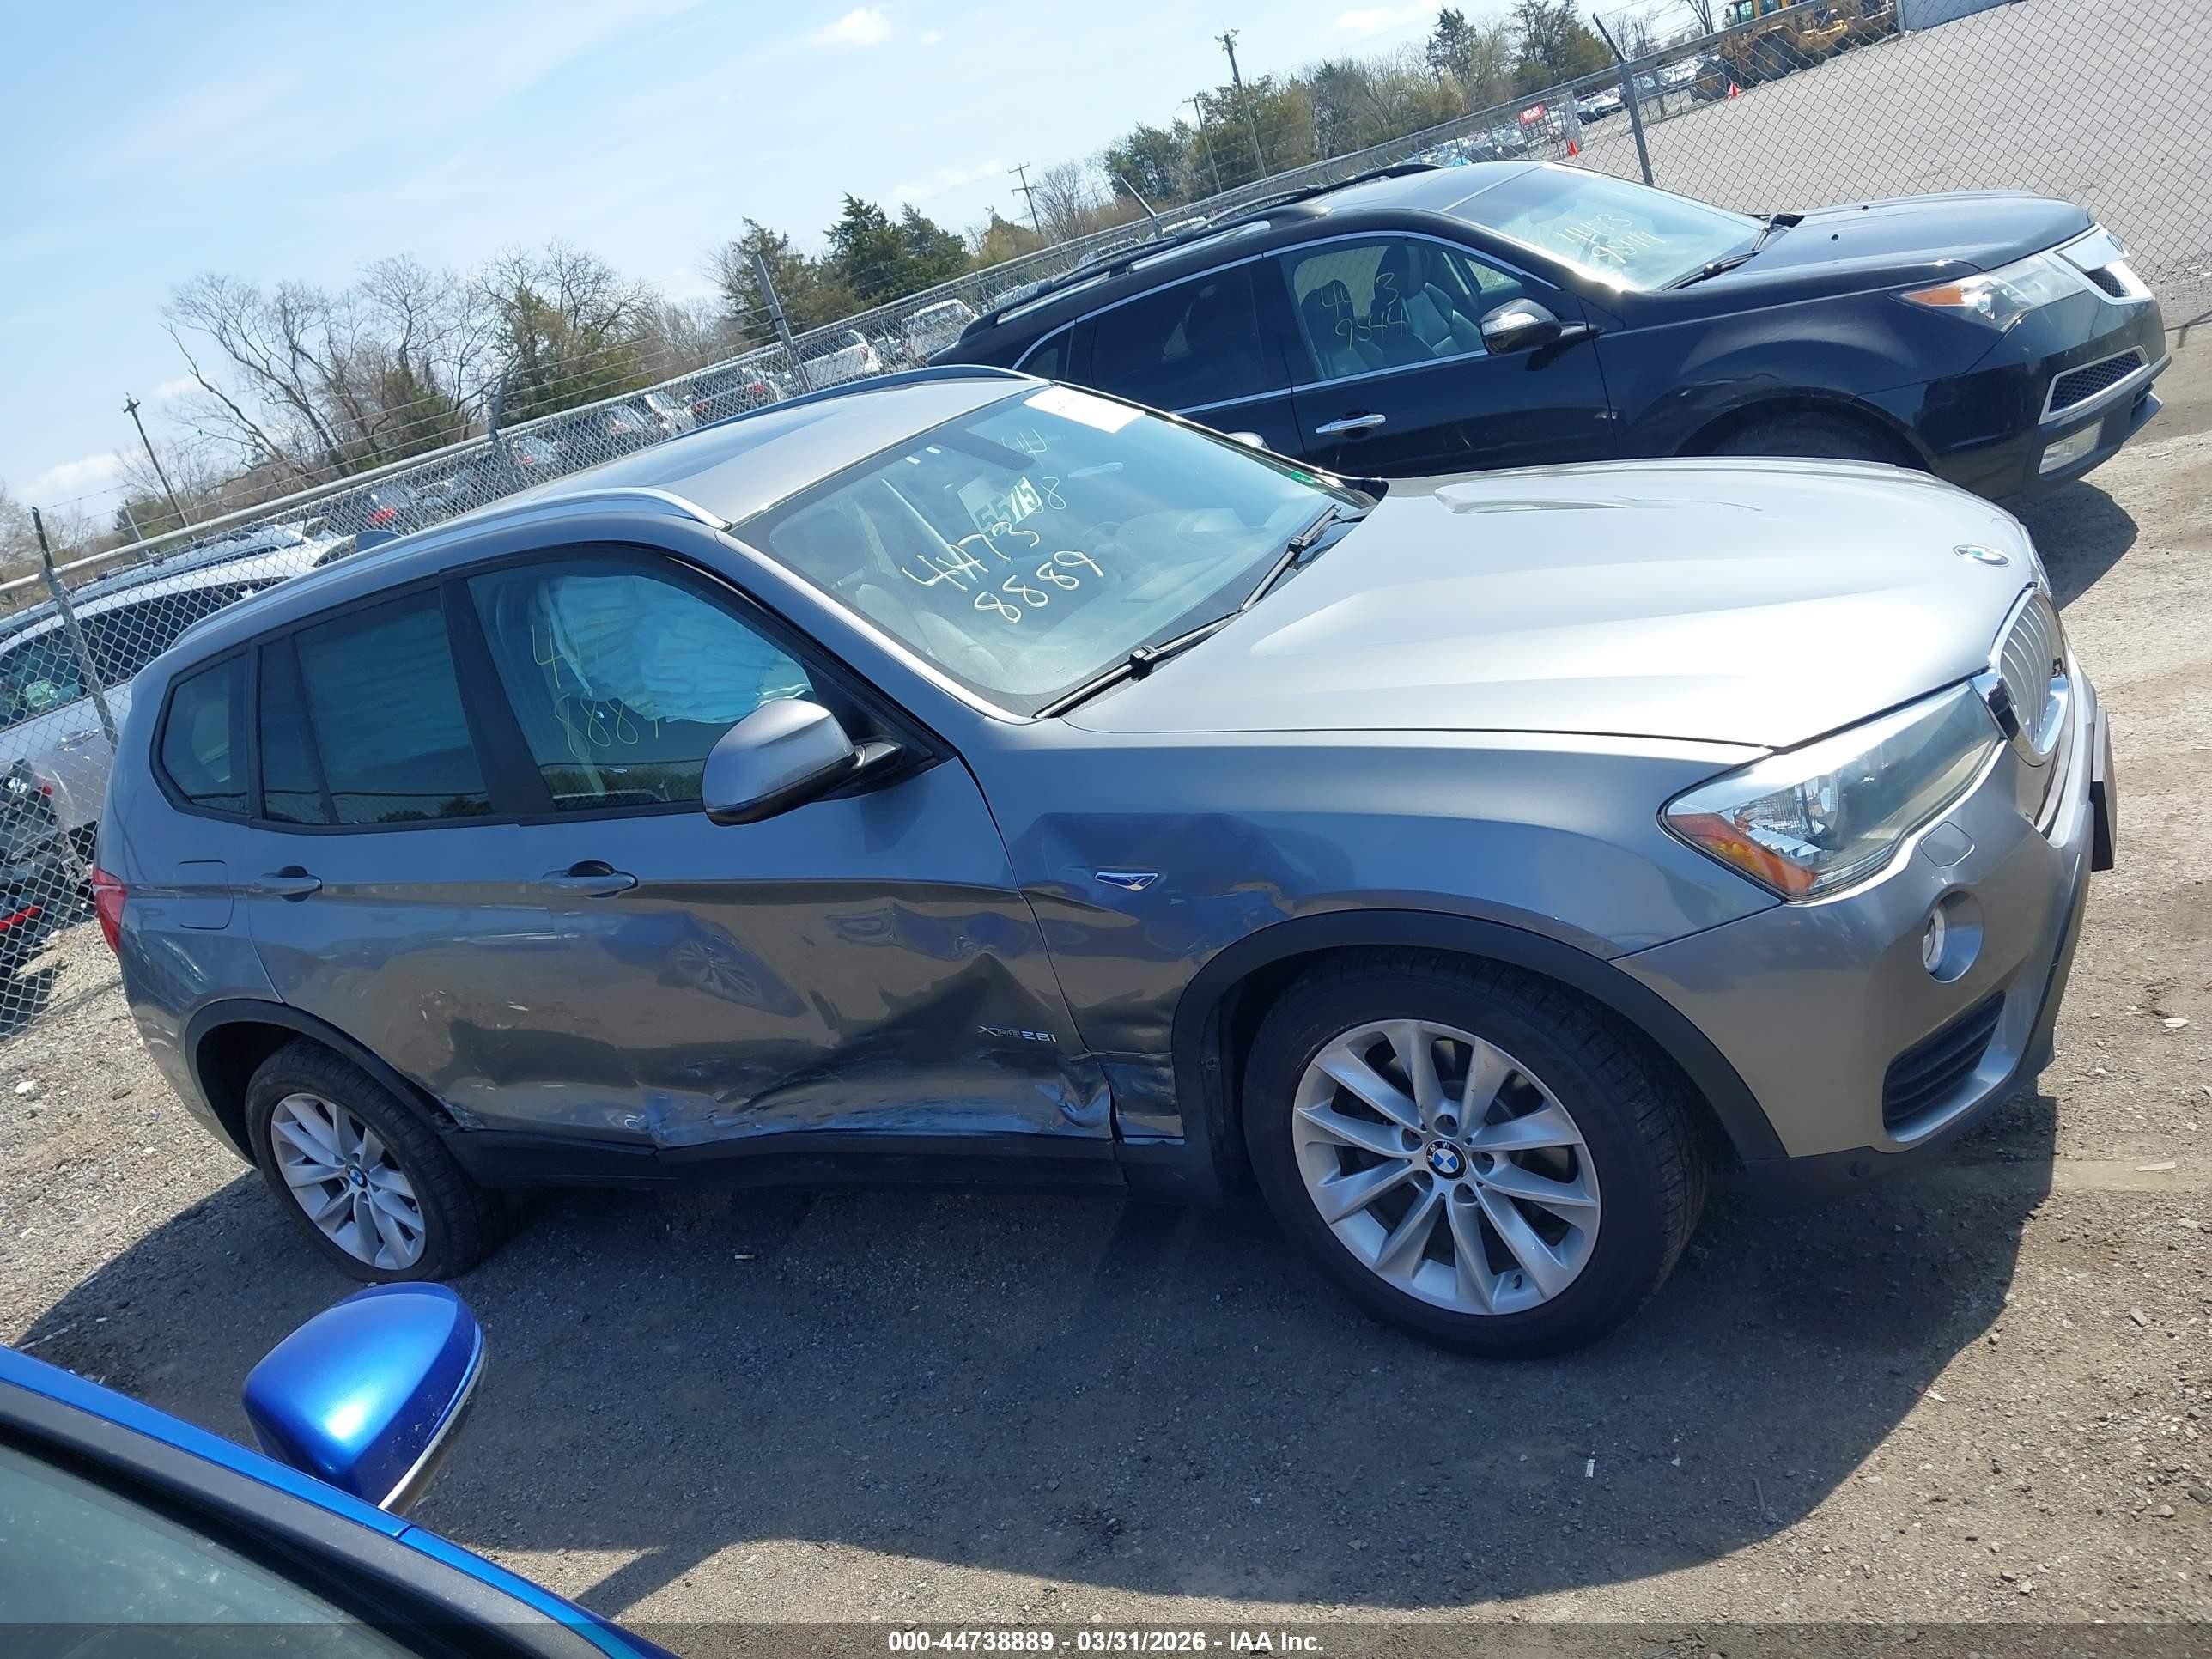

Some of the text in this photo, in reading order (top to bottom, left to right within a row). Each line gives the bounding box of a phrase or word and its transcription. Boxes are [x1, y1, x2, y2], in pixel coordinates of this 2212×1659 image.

[1334, 306, 1407, 351] 9544
[900, 520, 1041, 592] 4473
[974, 550, 1105, 623] 8889
